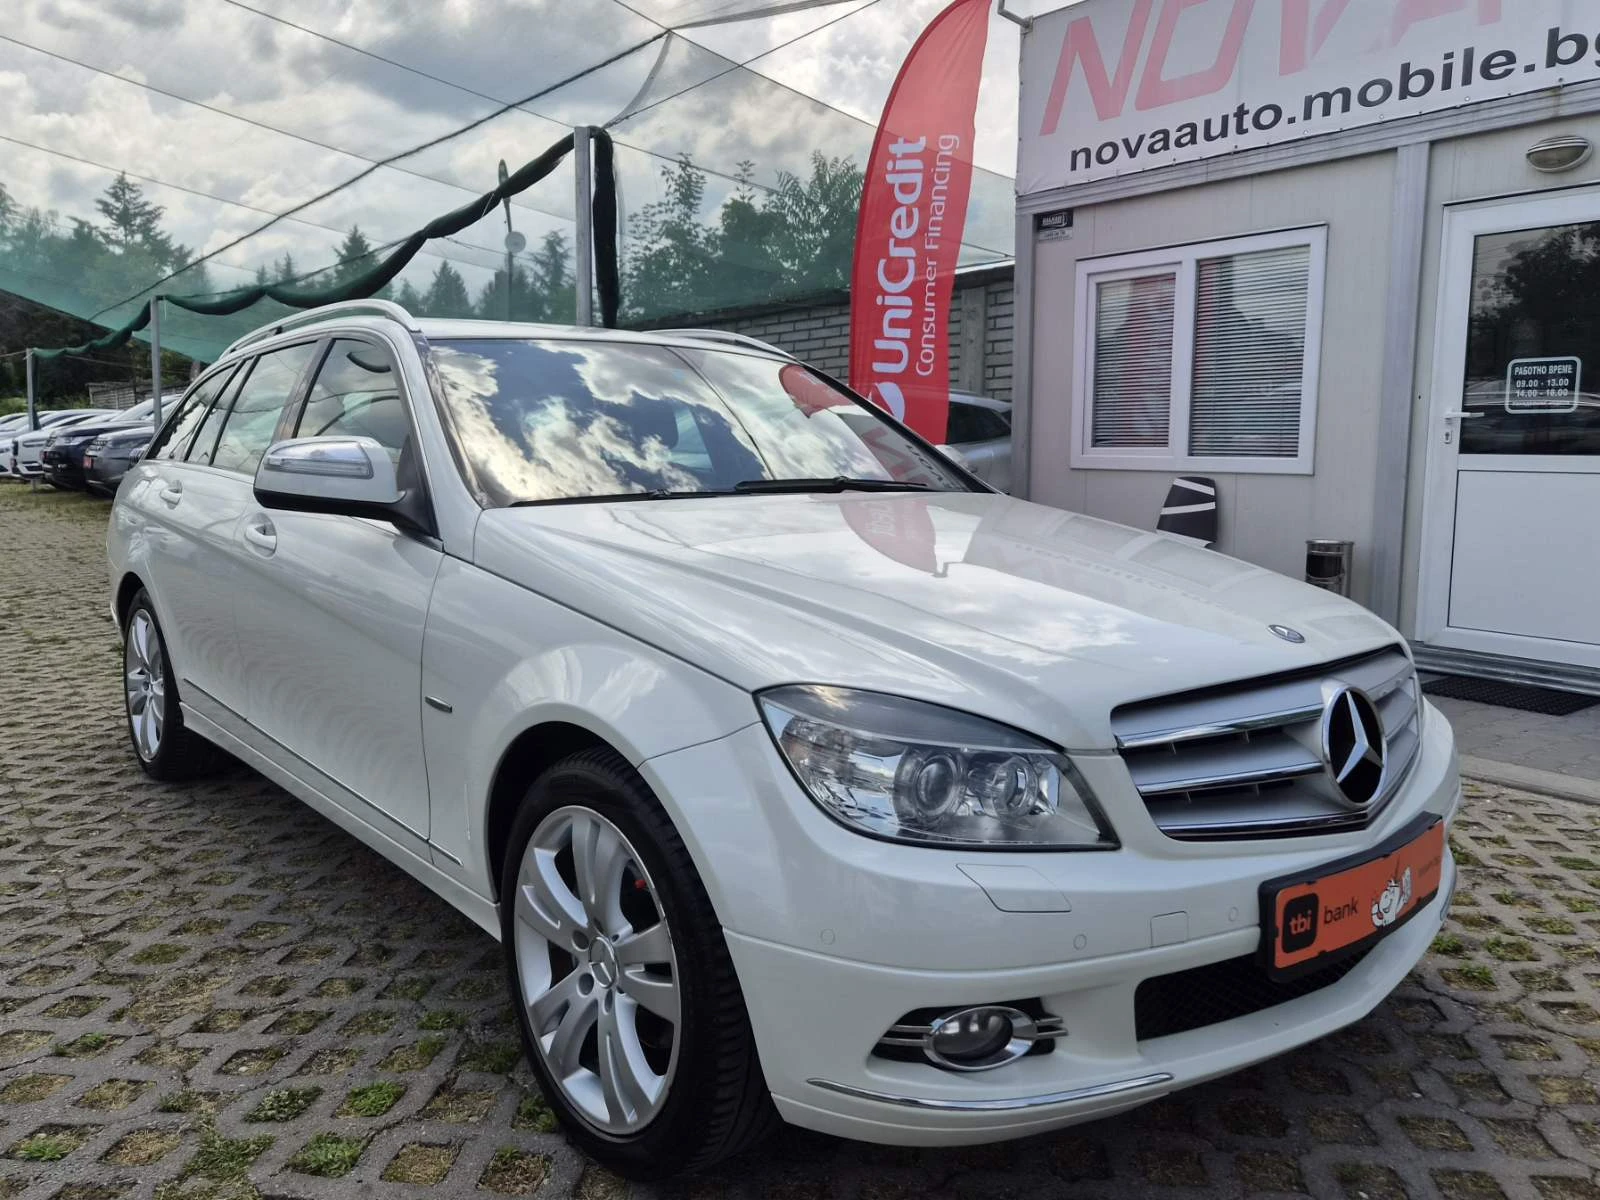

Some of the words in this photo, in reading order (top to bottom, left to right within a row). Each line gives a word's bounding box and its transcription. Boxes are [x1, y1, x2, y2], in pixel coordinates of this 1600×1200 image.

[924, 134, 960, 251] Financing
[872, 135, 927, 374] UniCredit
[915, 257, 938, 377] Consumer
[1289, 909, 1312, 935] tbi
[1324, 897, 1359, 925] bank
